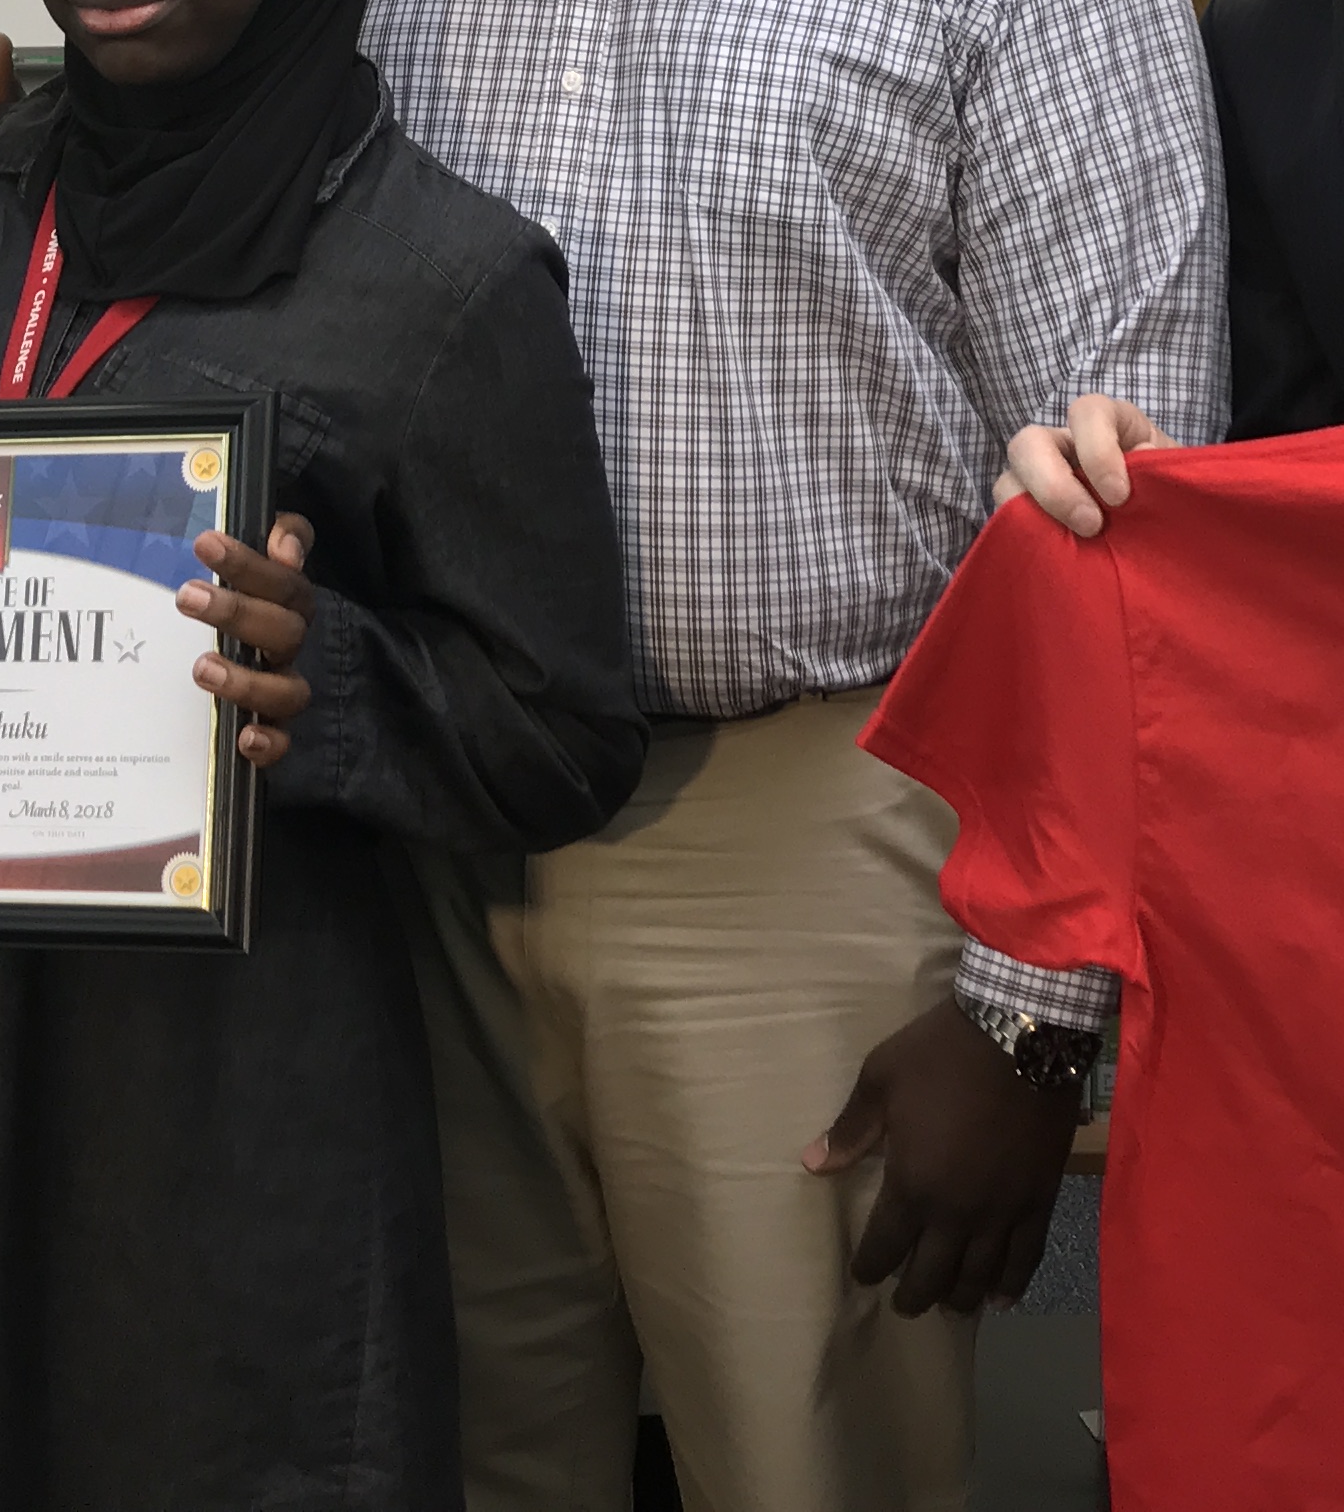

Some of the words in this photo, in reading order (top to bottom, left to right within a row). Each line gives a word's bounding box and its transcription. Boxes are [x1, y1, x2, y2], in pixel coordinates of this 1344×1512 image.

[12, 289, 46, 385] CHALLENGE
[24, 576, 56, 607] OF
[12, 752, 31, 762] with
[40, 752, 64, 762] smile
[67, 754, 92, 762] serves
[120, 753, 171, 765] inspiration
[28, 767, 62, 776] attitude
[64, 767, 81, 776] and
[9, 800, 56, 818] March
[58, 800, 69, 820] 8,
[73, 801, 114, 819] 2018
